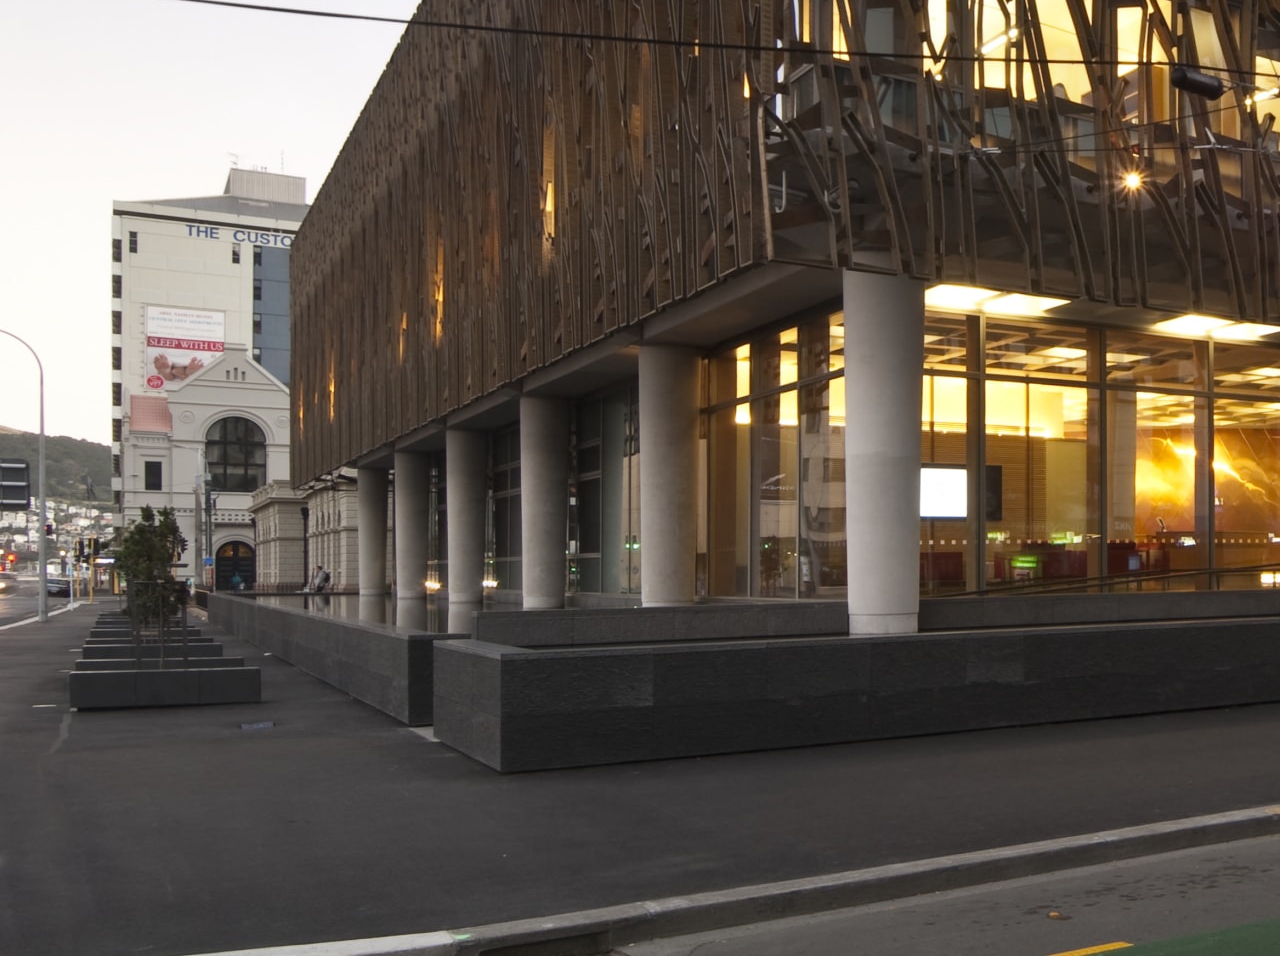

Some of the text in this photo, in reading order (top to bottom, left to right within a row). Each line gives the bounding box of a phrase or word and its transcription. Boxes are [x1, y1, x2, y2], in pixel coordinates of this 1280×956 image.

[185, 224, 219, 240] THE
[149, 338, 223, 351] SLEEP WITH US
